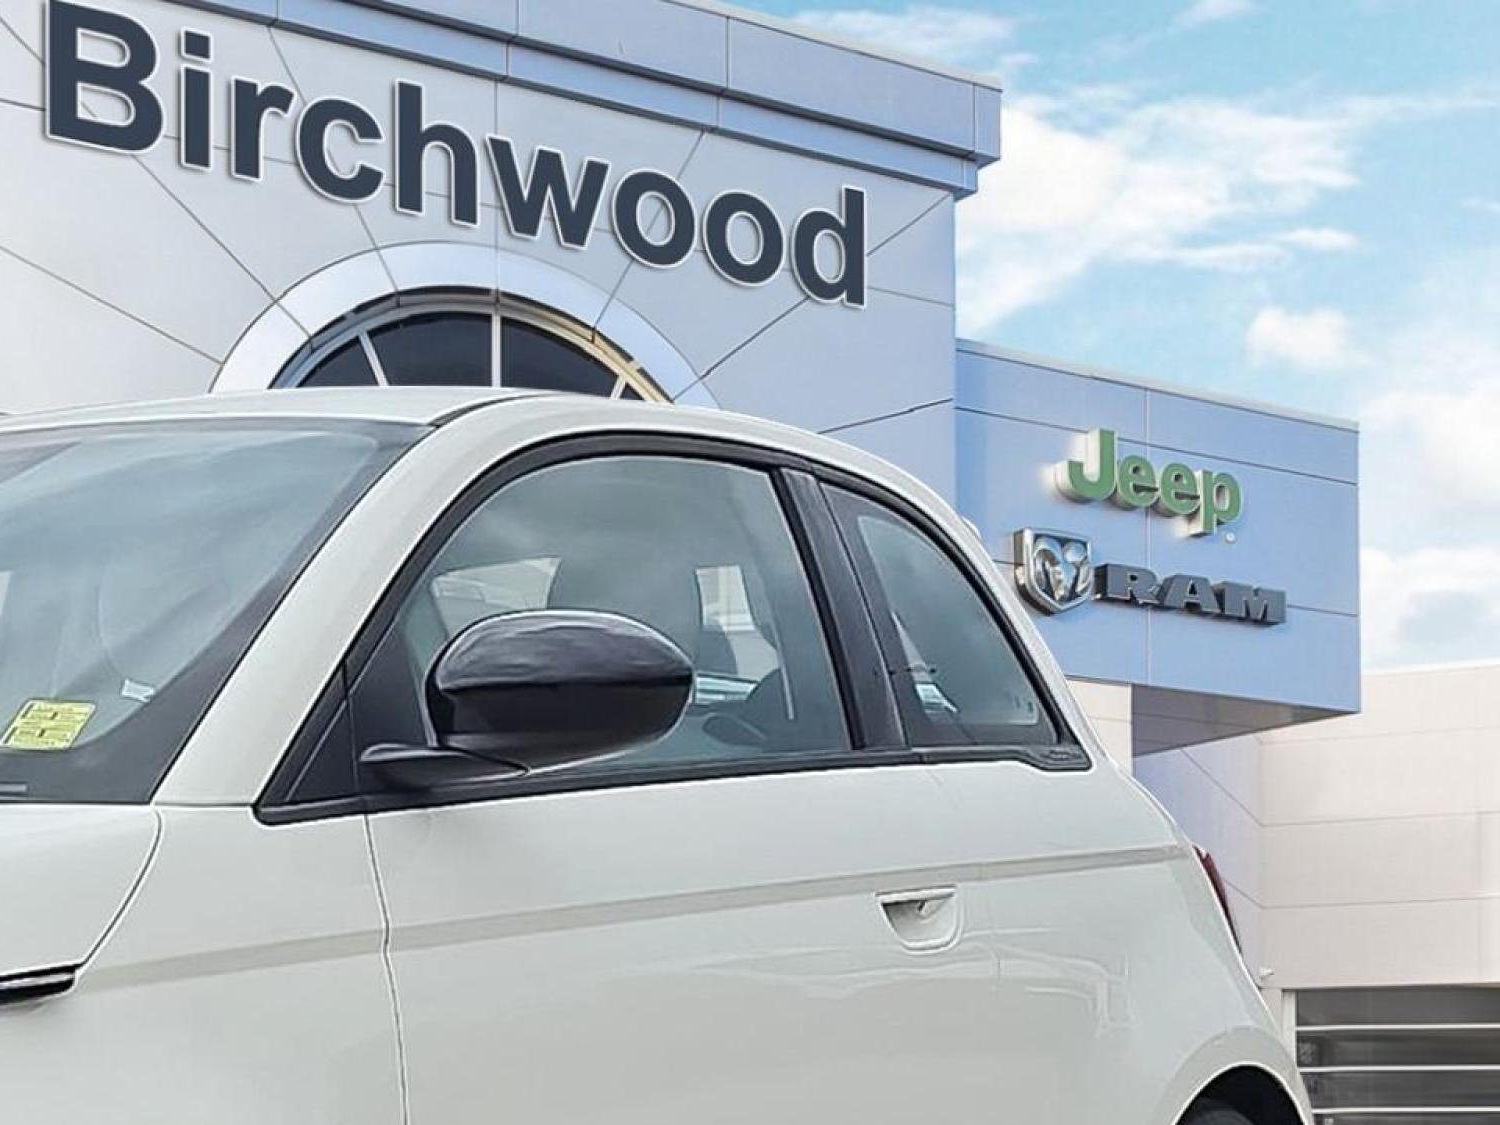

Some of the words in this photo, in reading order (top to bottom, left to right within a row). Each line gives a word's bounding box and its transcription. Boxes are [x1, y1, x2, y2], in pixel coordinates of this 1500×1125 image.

[46, 0, 867, 307] Birchwood
[1061, 428, 1243, 535] Jeep
[1096, 563, 1287, 625] RAM
